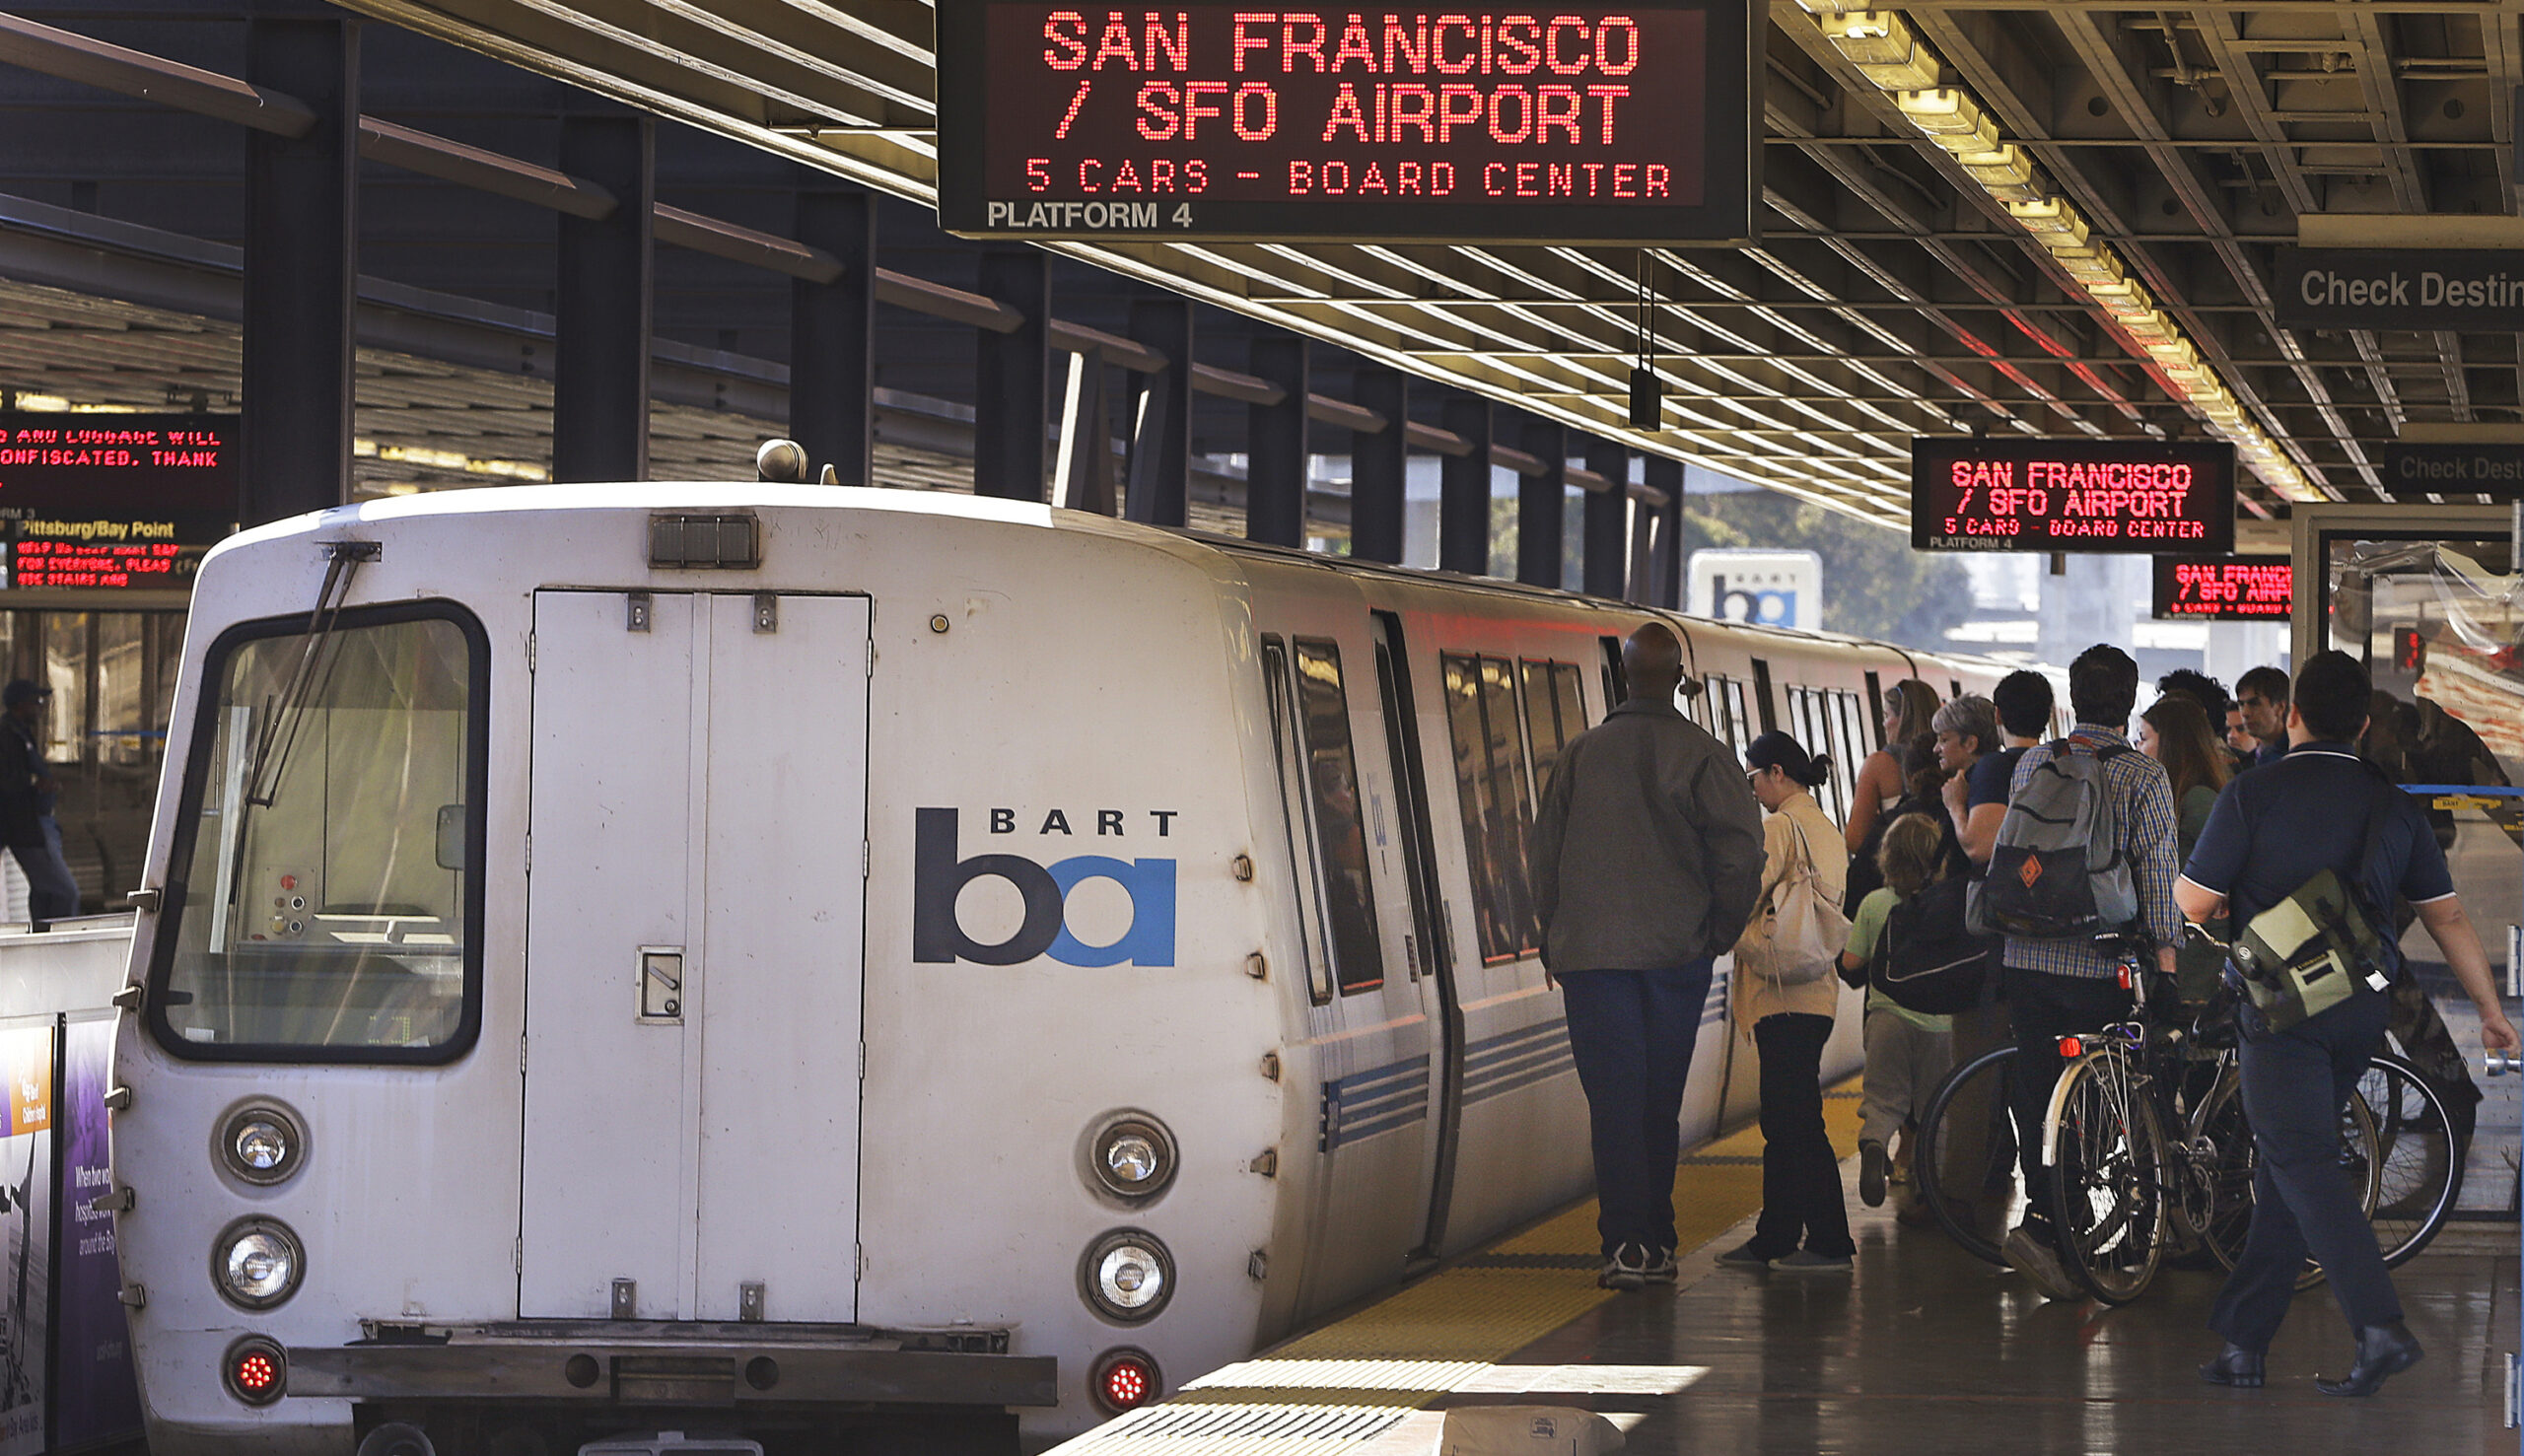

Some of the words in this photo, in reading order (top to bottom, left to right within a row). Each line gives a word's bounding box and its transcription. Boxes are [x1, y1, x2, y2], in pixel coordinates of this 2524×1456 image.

[1044, 11, 1188, 72] SAN
[1233, 12, 1640, 76] FRANCISCO
[1056, 80, 1090, 140] /
[1136, 80, 1278, 142] SFO
[1321, 83, 1632, 145] AIRPORT
[1026, 158, 1051, 192] 5
[1080, 159, 1209, 193] CARS
[1289, 160, 1455, 195] BOARD
[1483, 162, 1670, 198] CENTER
[988, 201, 1158, 228] PLATFORM
[1171, 201, 1193, 228] 4
[2301, 269, 2409, 307] Check
[151, 451, 218, 467] THANK
[2400, 456, 2466, 479] Check
[1951, 460, 2013, 488] SAN
[2027, 462, 2193, 490] FRANCISCO
[1956, 488, 1974, 515] /
[1988, 489, 2049, 517] SFO
[2063, 491, 2189, 518] AIRPORT
[131, 521, 175, 538] Point
[1944, 517, 1957, 534] 5
[1965, 518, 2021, 536] CARS
[2049, 520, 2120, 537] BOARD
[2126, 520, 2206, 539] CENTER
[1929, 536, 1999, 548] PLATFORM
[2003, 537, 2012, 548] 4
[2175, 564, 2216, 585] SAN
[2199, 582, 2239, 601] SFO
[989, 807, 1179, 837] BART
